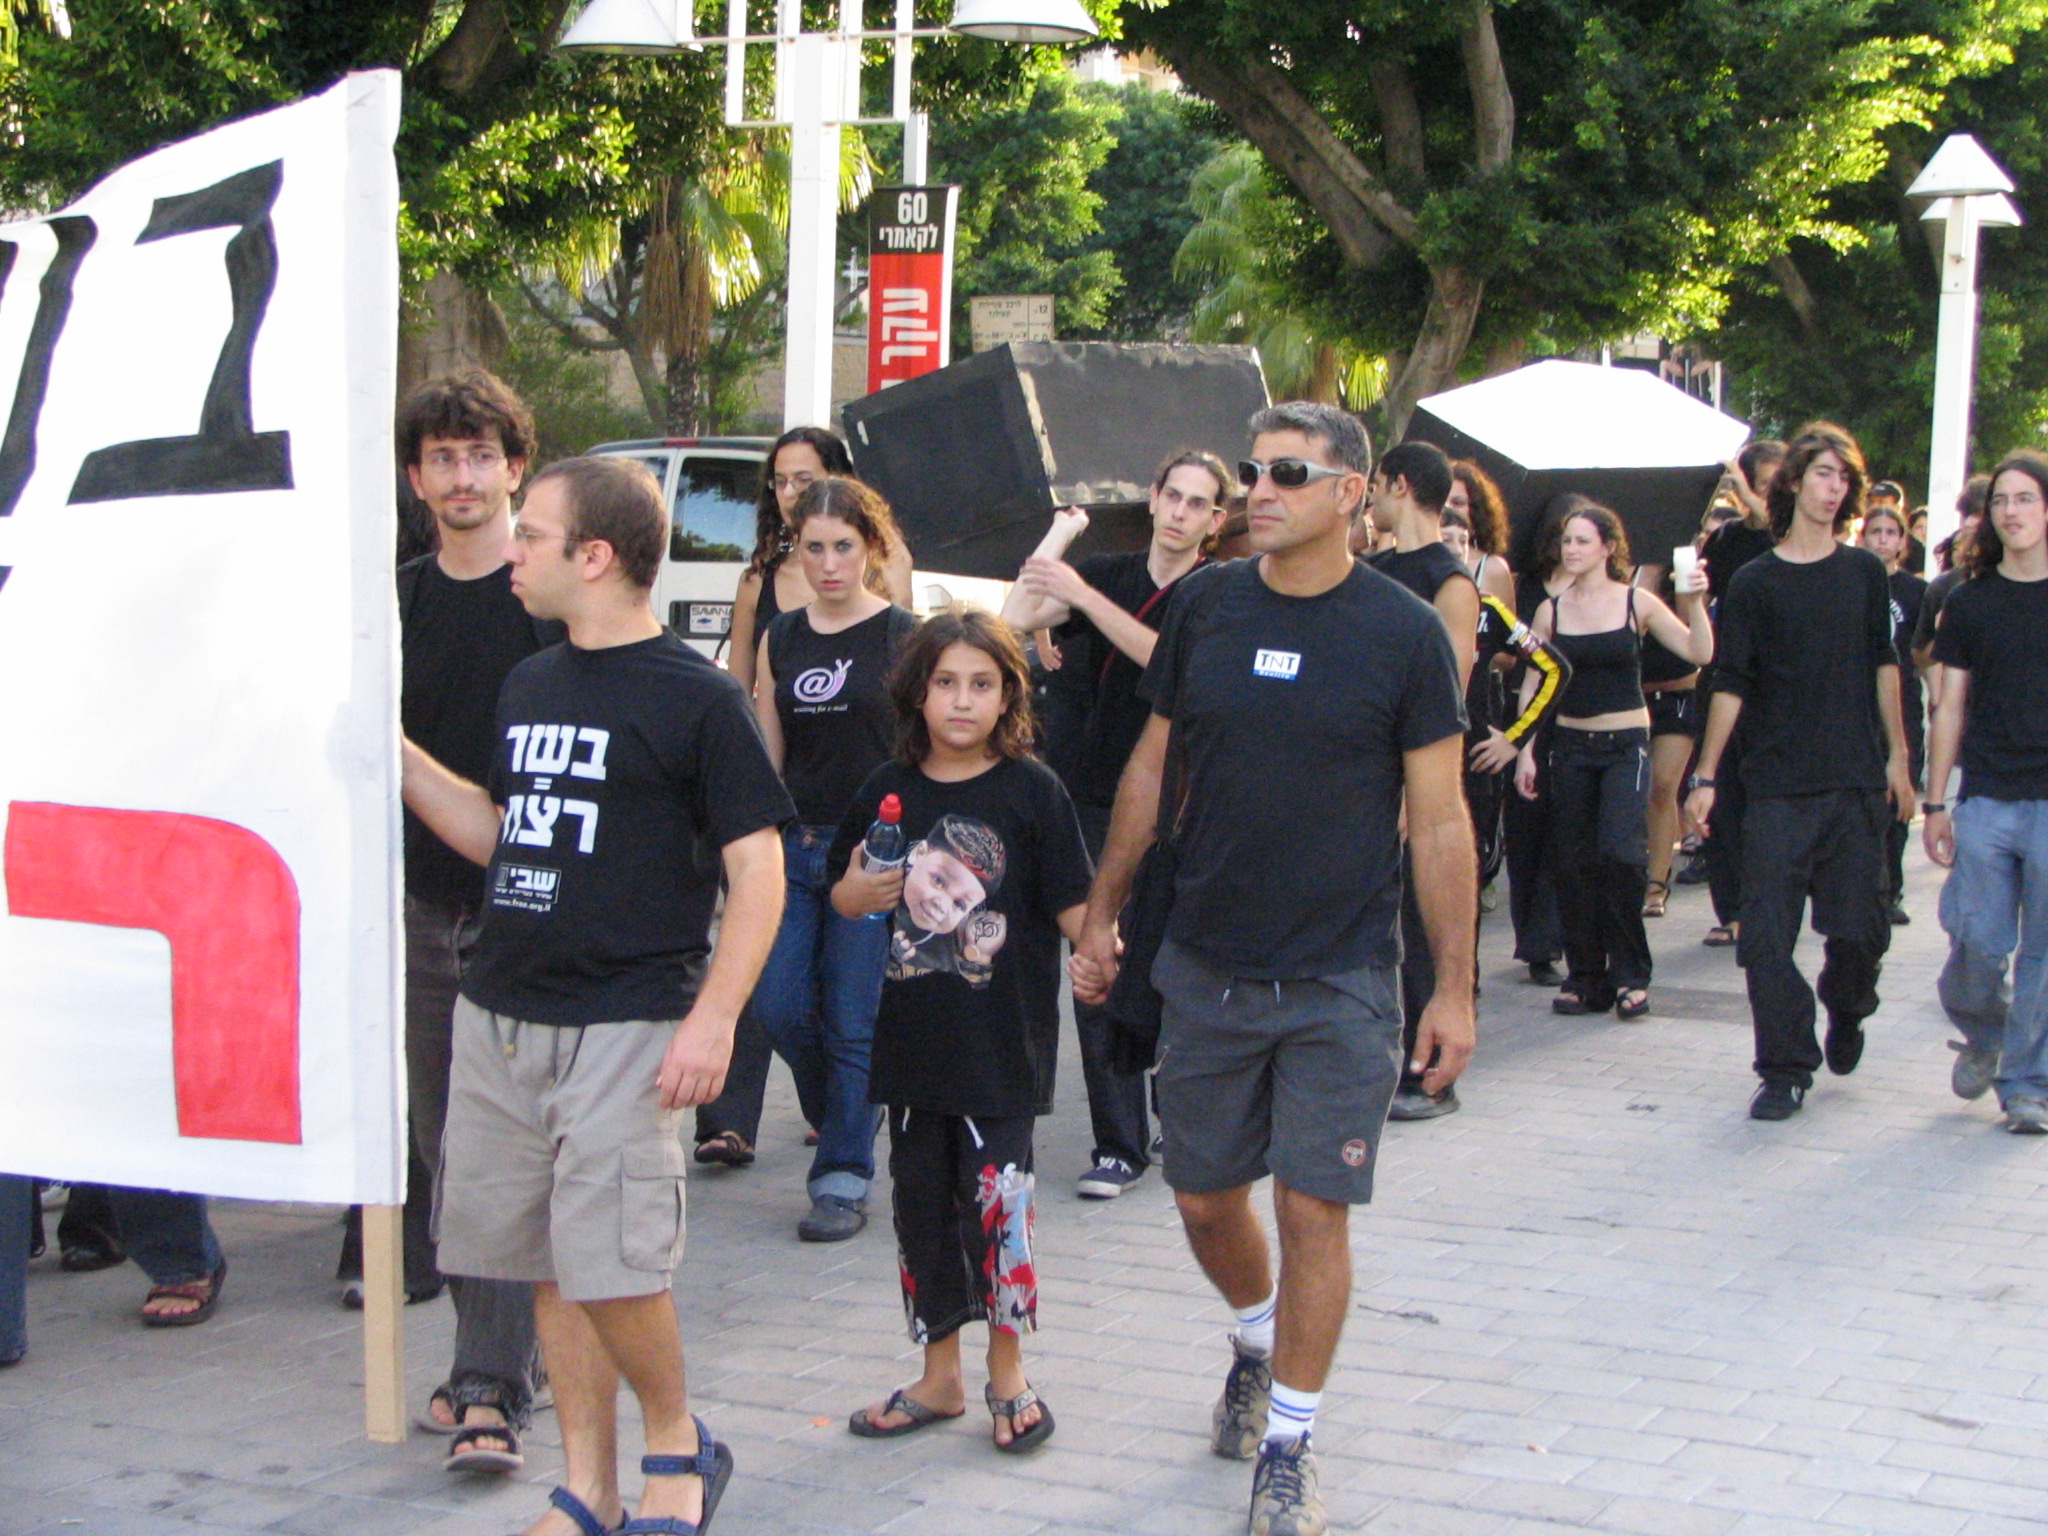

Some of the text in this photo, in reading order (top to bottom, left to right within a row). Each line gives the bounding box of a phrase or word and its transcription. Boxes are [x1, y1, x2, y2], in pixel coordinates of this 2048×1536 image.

[898, 192, 928, 225] 60
[879, 223, 939, 252] לקאמרי
[1260, 653, 1297, 671] TNT
[506, 724, 610, 781] בשר
[501, 794, 599, 854] רצח
